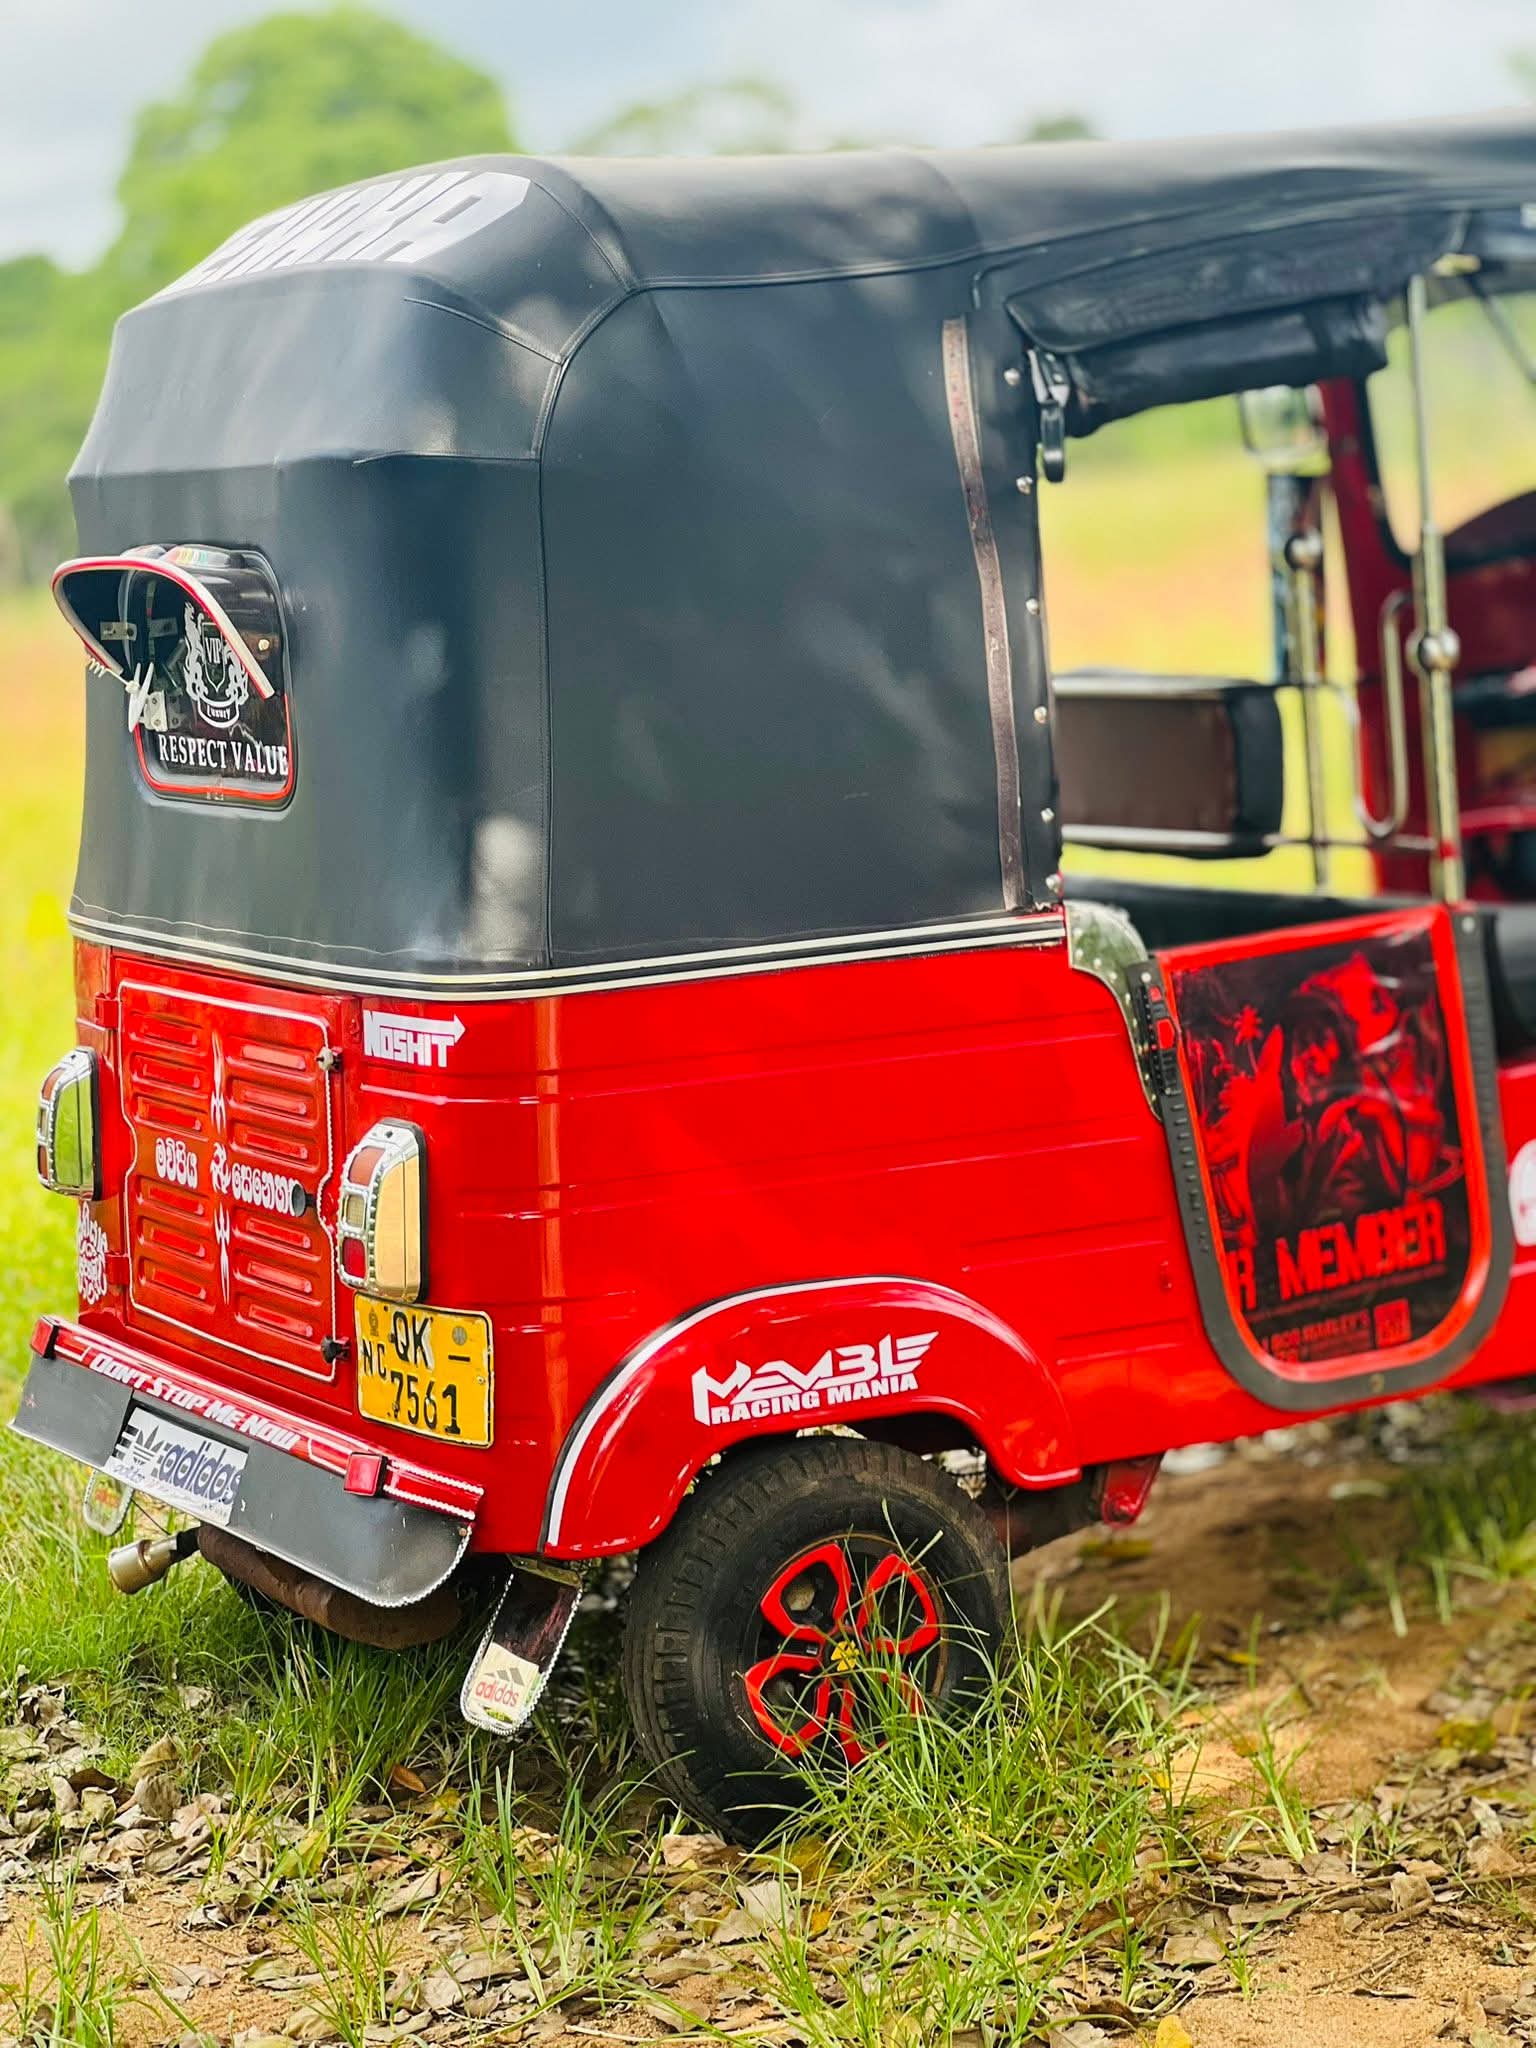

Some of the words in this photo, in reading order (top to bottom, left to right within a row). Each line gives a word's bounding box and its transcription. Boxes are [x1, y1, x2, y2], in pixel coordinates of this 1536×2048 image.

[204, 637, 221, 664] VIP
[158, 735, 227, 769] RESPECT
[229, 741, 288, 776] VALUE
[1276, 1198, 1446, 1300] MEMBER
[362, 1338, 386, 1378] NC
[392, 1311, 430, 1369] QK
[147, 1376, 210, 1410] STOP
[203, 1398, 246, 1429] ME
[239, 1413, 300, 1450] NOW
[390, 1370, 461, 1435] 7561
[711, 1391, 821, 1425] RACING
[827, 1373, 919, 1405] MANIA
[158, 1439, 242, 1505] adidas
[475, 1680, 519, 1707] adidas
